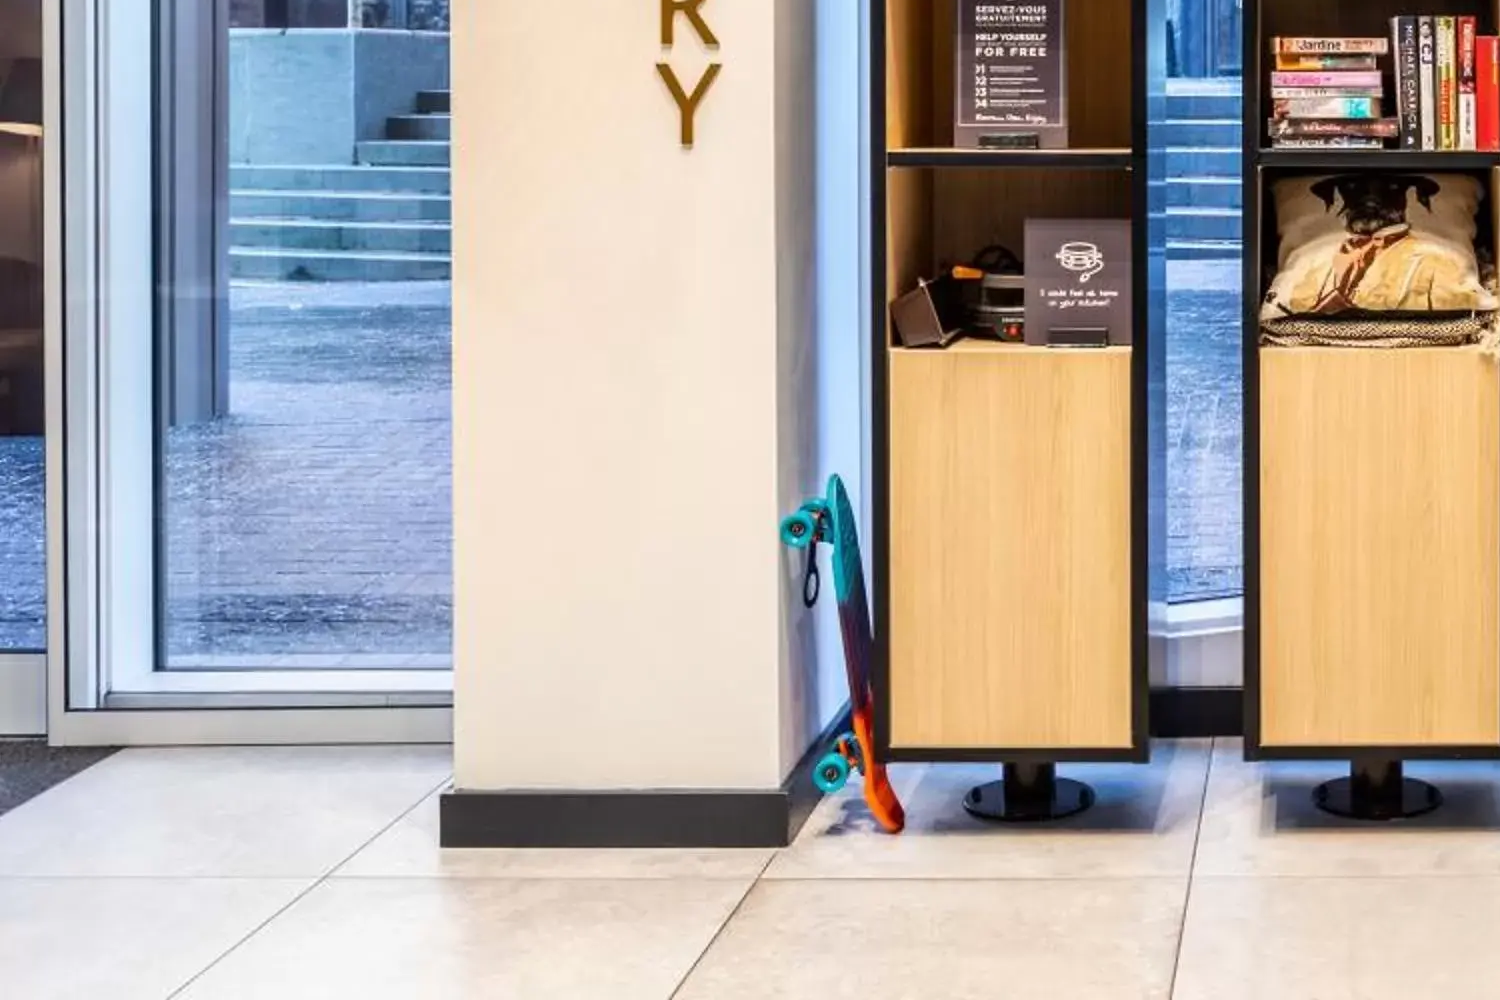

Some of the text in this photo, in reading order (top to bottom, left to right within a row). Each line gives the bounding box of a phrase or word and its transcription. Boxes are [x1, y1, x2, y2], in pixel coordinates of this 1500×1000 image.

[975, 5, 1047, 14] SERVEZ-VOUS
[975, 33, 1047, 41] HELP YOURSELF
[975, 47, 1047, 57] FOR FREE
